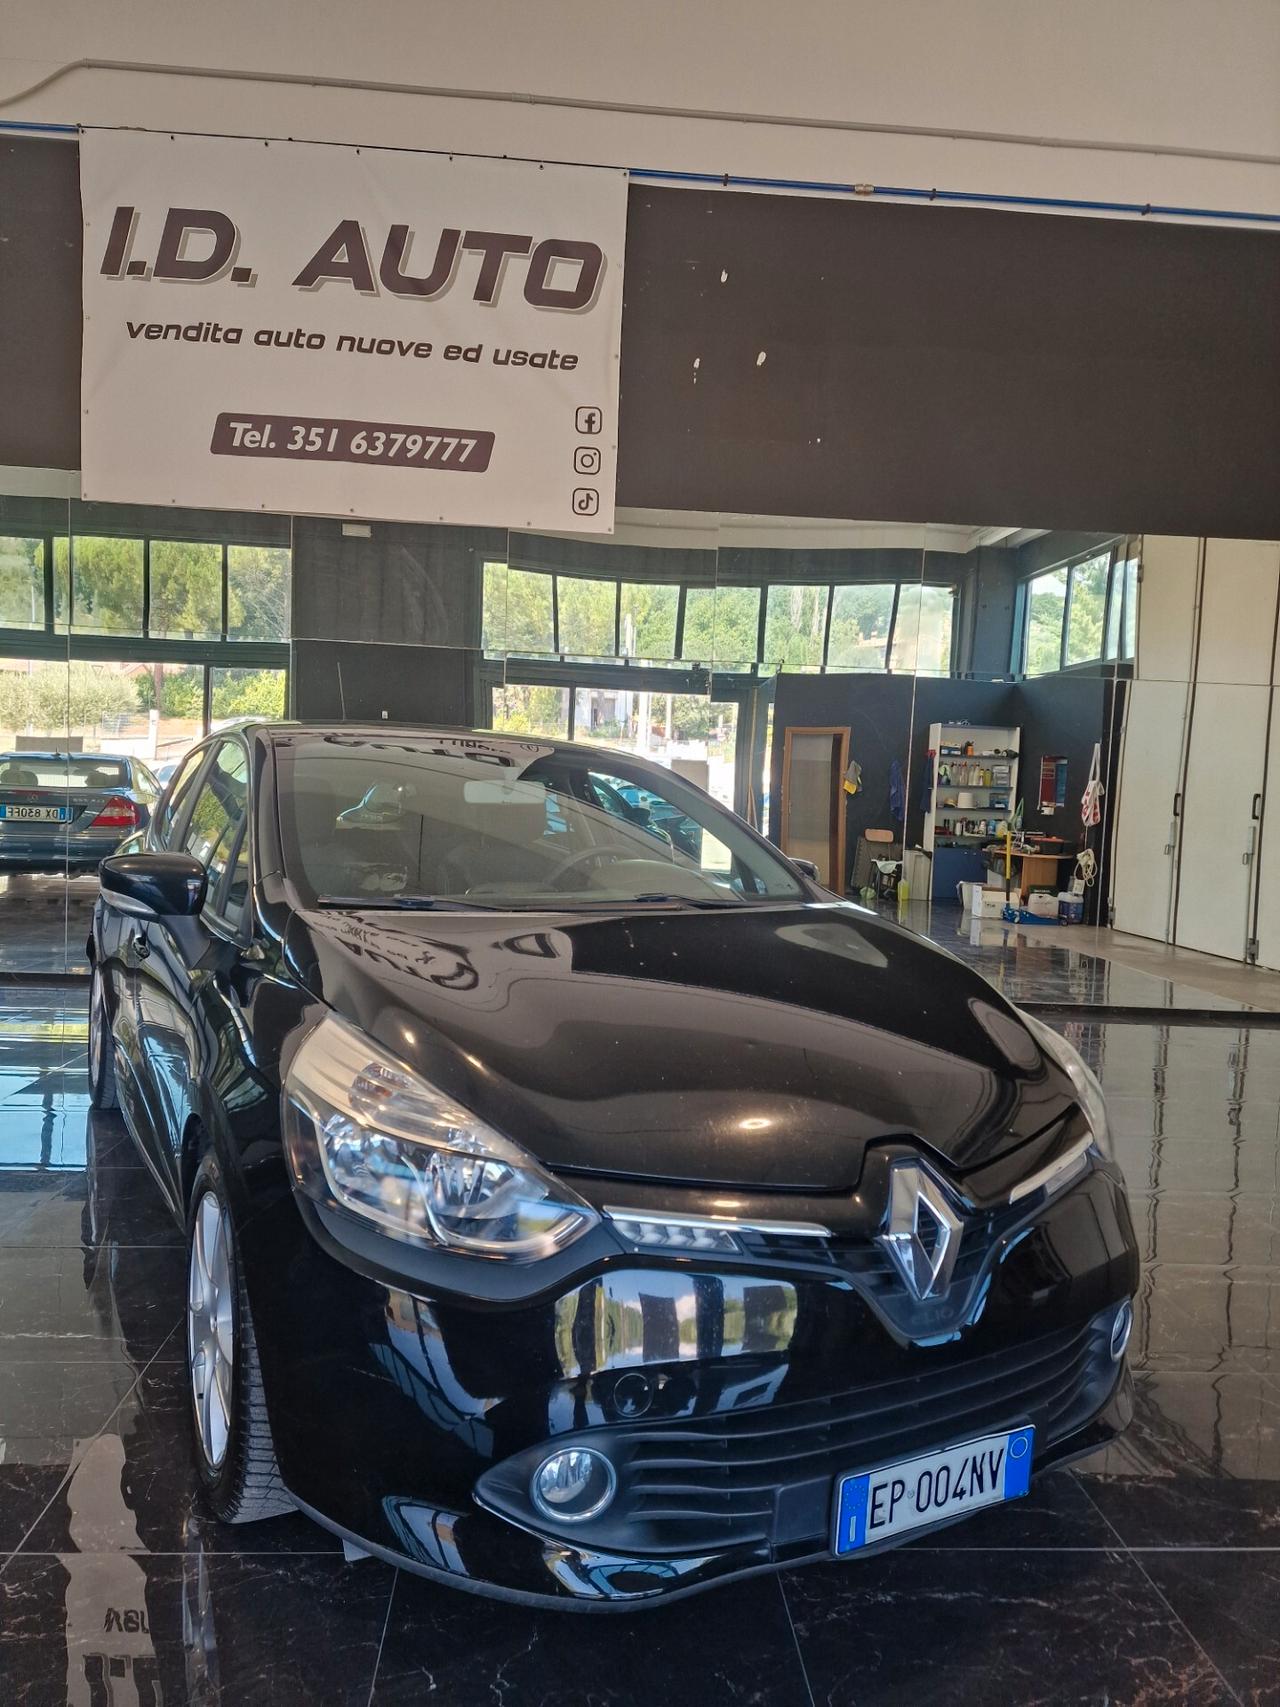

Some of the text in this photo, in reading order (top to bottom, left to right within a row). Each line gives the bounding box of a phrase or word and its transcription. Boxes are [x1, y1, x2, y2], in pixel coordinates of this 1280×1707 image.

[100, 206, 607, 314] I.D. AUTO
[126, 321, 579, 371] vendita auto nuove ed usate
[229, 422, 477, 464] Tel. 351 6379777
[870, 1479, 906, 1530] EP
[915, 1448, 1005, 1513] 004NV
